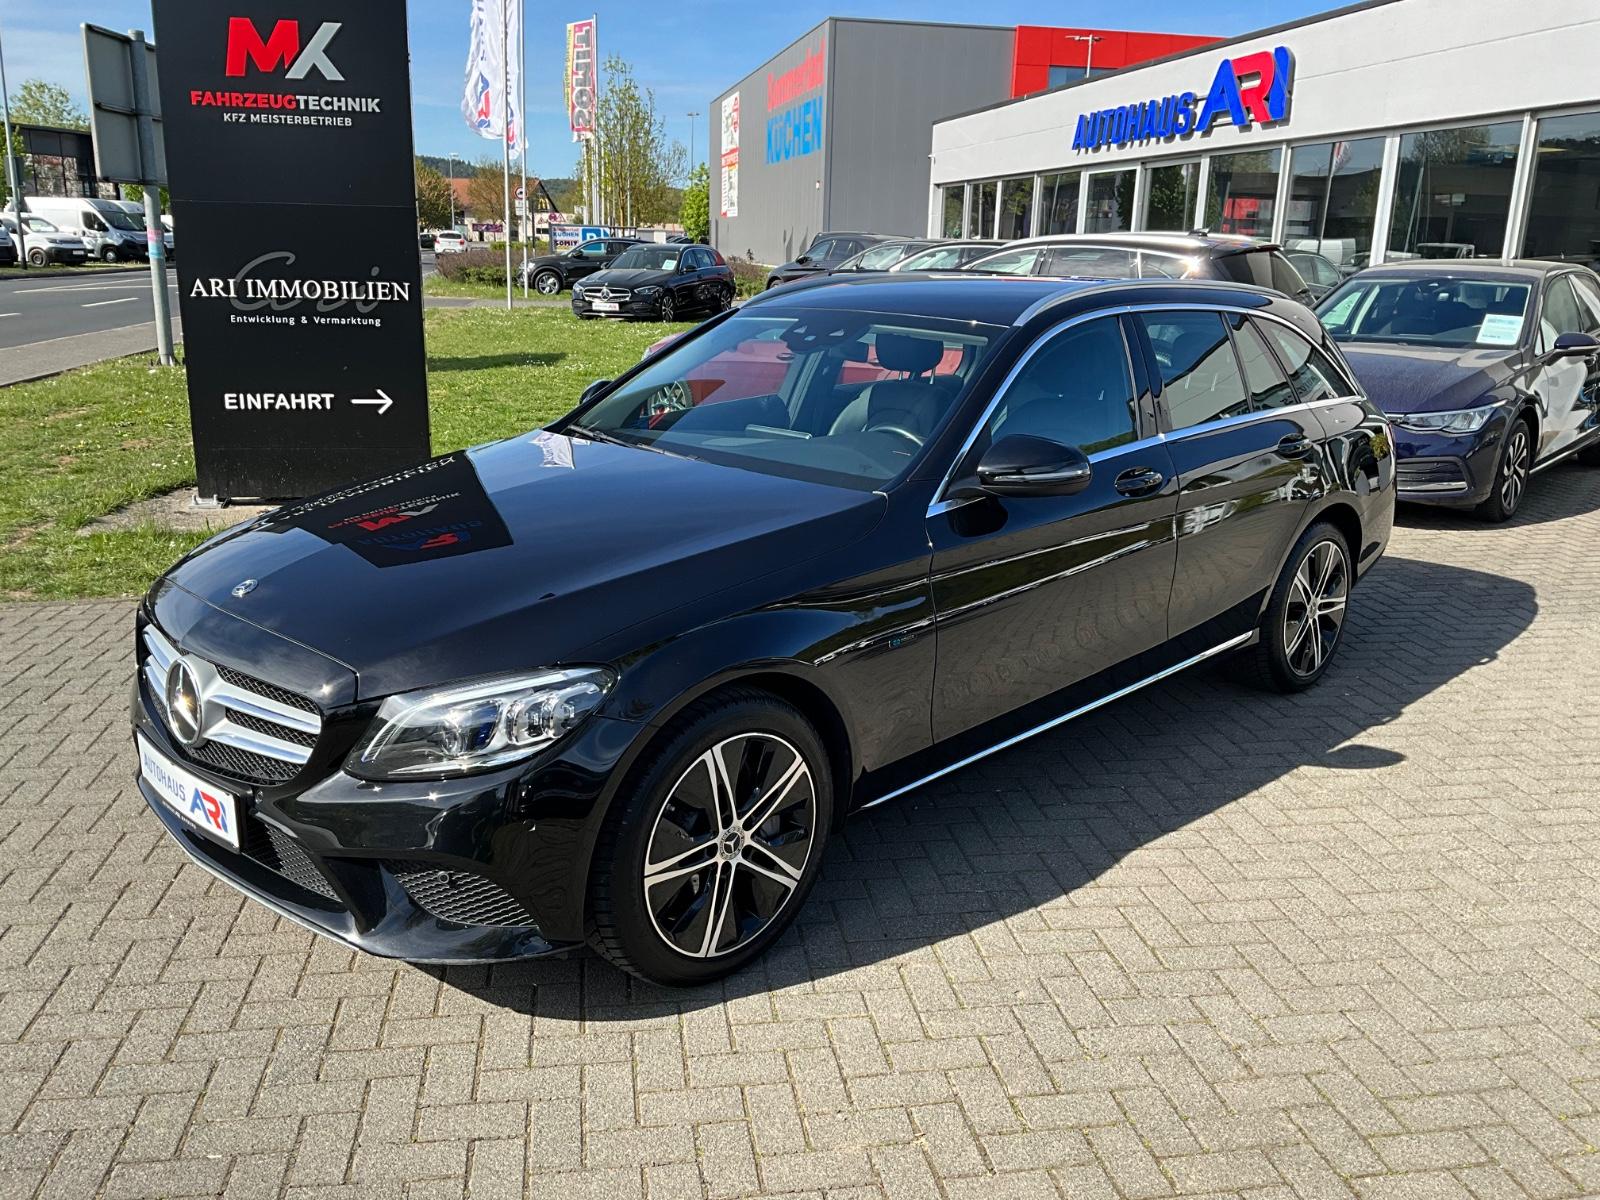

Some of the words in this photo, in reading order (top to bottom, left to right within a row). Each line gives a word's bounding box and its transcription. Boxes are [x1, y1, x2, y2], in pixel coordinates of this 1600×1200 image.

[225, 17, 345, 81] MK
[190, 90, 381, 113] FAHRZEUGTECHNIK
[1072, 92, 1195, 150] AUTOHAUS
[1196, 46, 1296, 133] ARI
[223, 113, 247, 123] KFZ
[250, 114, 352, 127] MEISTERBETRIEB
[766, 96, 823, 164] KÜCHEN
[190, 278, 237, 299] ARI
[246, 279, 410, 301] IMMOBILIEN
[230, 314, 295, 326] Entwicklung
[300, 316, 308, 324] &
[313, 316, 382, 327] Vermarktung
[223, 393, 335, 411] EINFAHRT
[144, 753, 186, 801] AUTOHAUS
[189, 787, 230, 834] ARI
